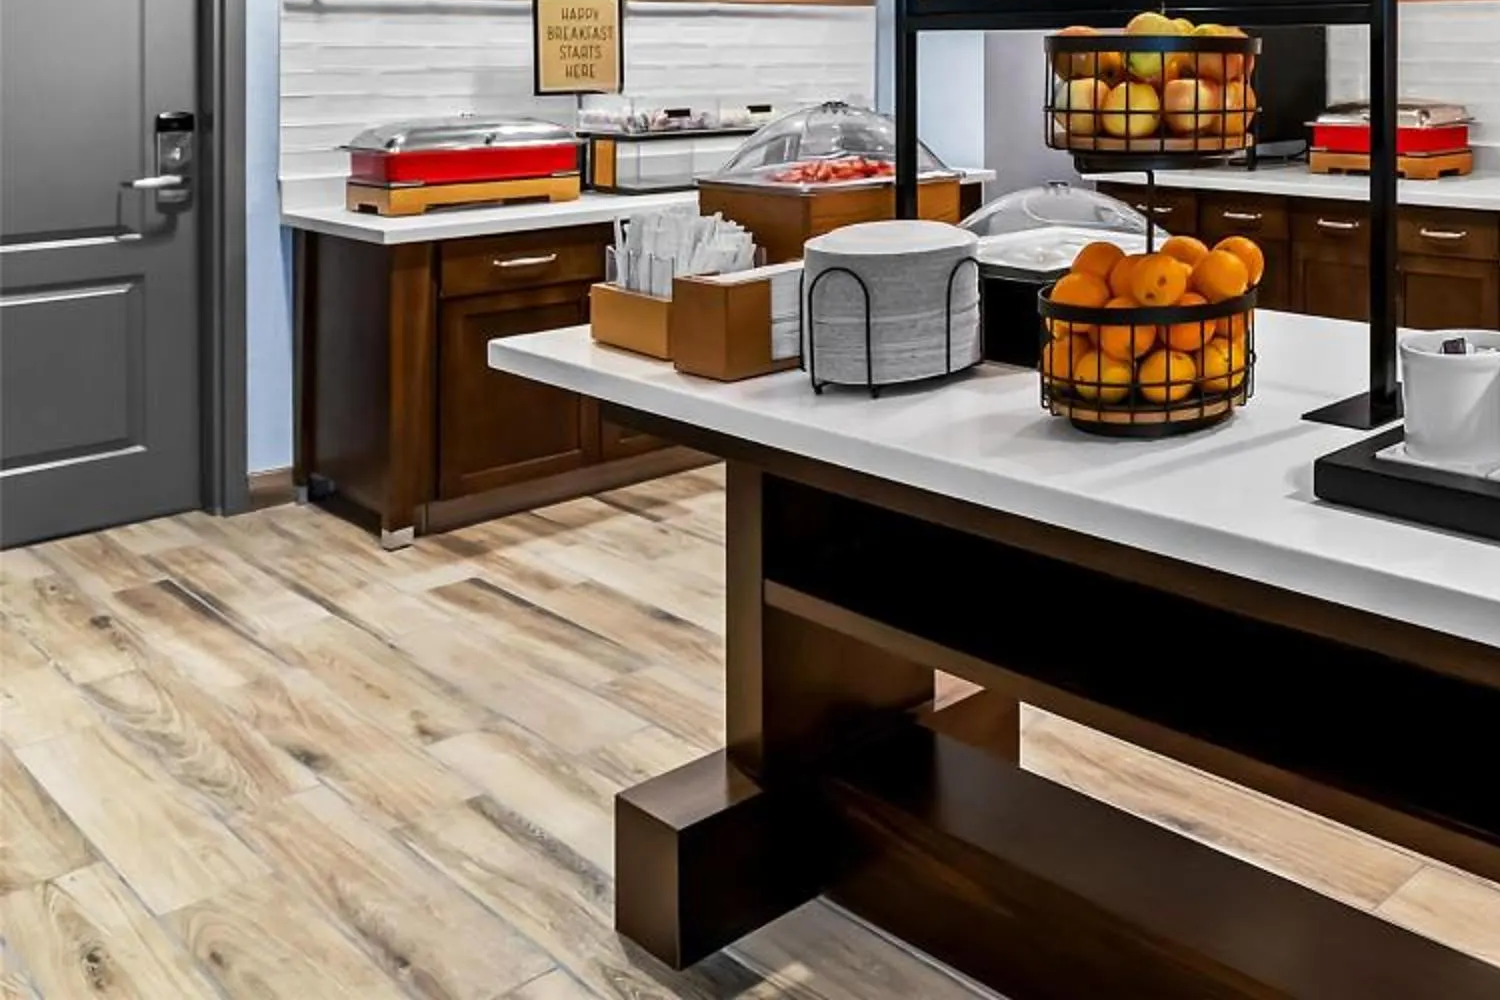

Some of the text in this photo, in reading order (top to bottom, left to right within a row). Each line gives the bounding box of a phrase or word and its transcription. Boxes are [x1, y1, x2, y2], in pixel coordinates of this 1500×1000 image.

[560, 7, 600, 21] HAPPY
[546, 24, 614, 42] BREAKFAST
[558, 44, 603, 61] STARTS
[564, 62, 597, 79] HERE
